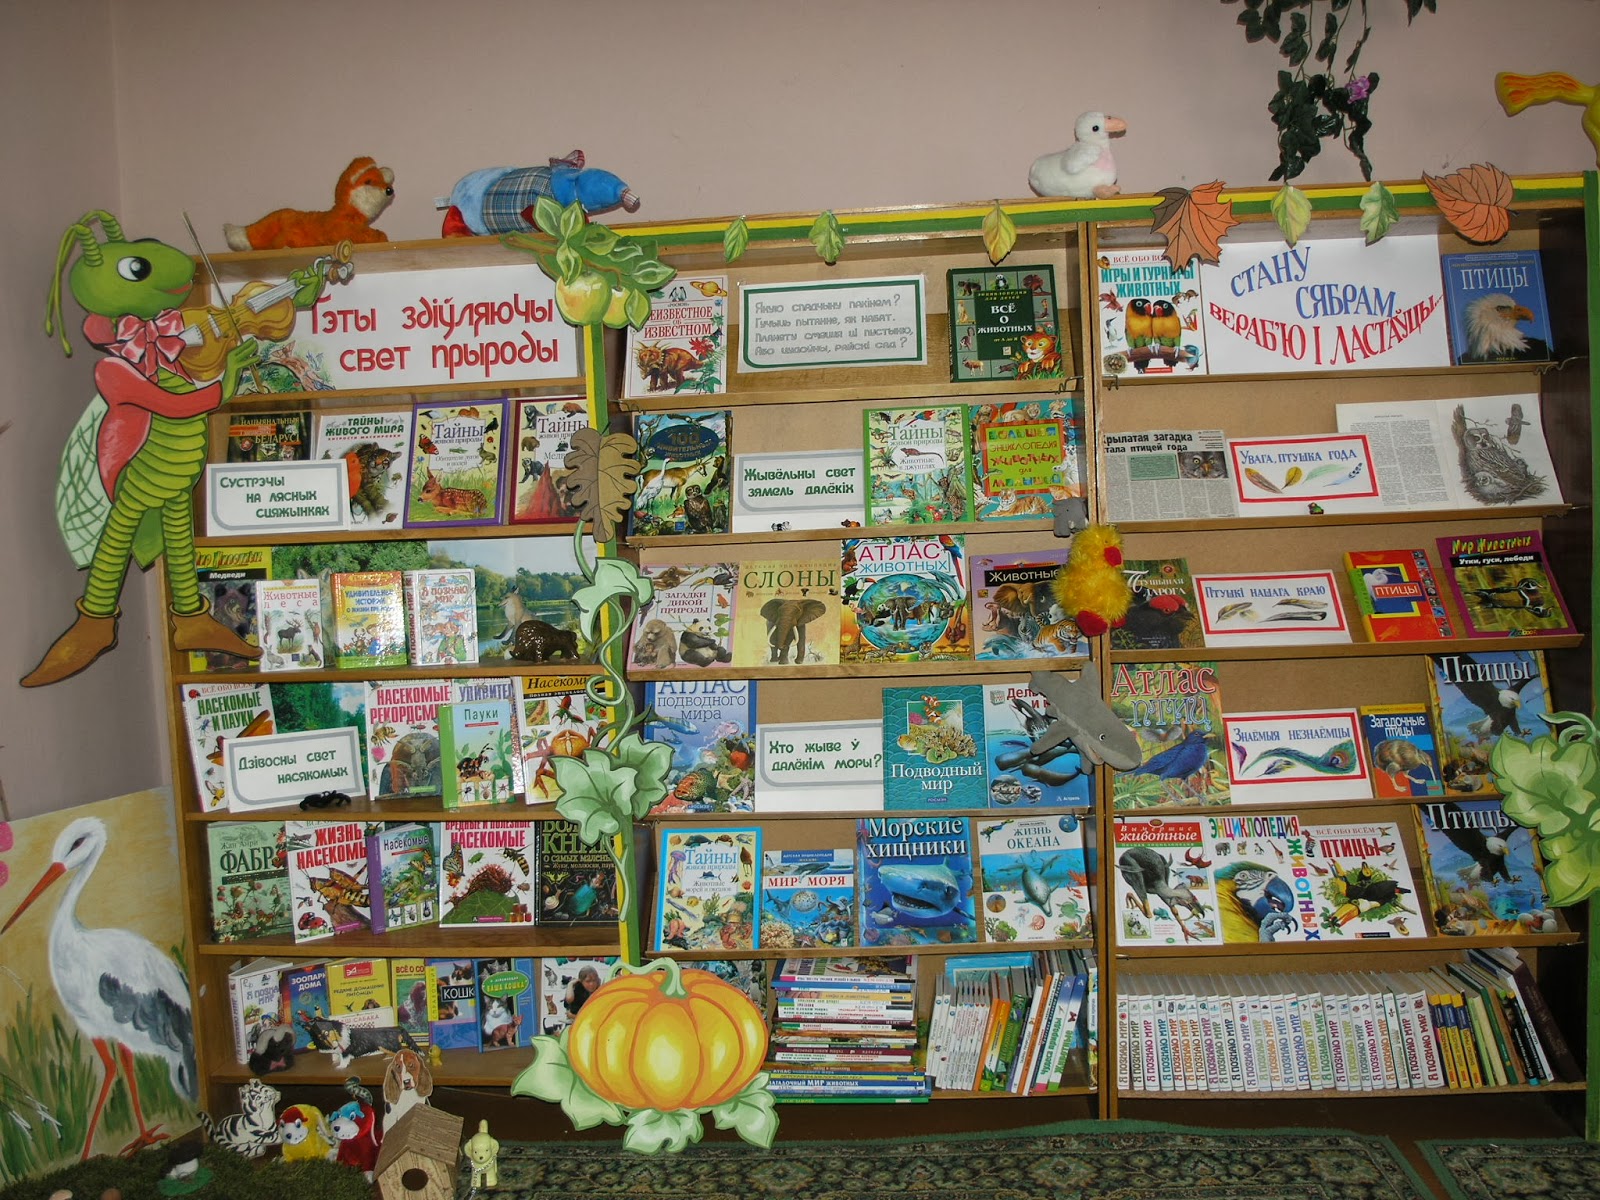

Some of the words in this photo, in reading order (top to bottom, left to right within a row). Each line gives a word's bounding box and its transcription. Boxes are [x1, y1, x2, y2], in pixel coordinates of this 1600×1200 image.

[1101, 267, 1131, 283] ИГРЫ
[1133, 266, 1140, 281] И
[1231, 246, 1311, 297] СТАНУ
[1461, 267, 1529, 293] ПТИЦЫ
[1116, 281, 1182, 298] ЖИВОТНЫХ
[755, 301, 784, 314] Якую
[791, 301, 842, 313] спадчыну
[991, 303, 1017, 314] ВСЁ
[1296, 283, 1396, 319] СЯБРАМ
[311, 293, 376, 334] Гэты
[401, 294, 554, 340] здіўляючы
[844, 316, 857, 324] як
[1000, 315, 1009, 324] О
[644, 323, 713, 339] ИЗВЕСТНОМ
[340, 345, 411, 372] свет
[432, 330, 558, 379] прыроды
[348, 415, 384, 425] ТАЙНЫ
[326, 427, 370, 436] ЖИВОГО
[373, 424, 404, 434] МИРА
[434, 423, 484, 439] Тайны
[889, 423, 943, 441] Тайны
[988, 426, 1057, 440] БОЛЬШАЯ
[1154, 433, 1193, 443] загадка
[989, 442, 1058, 453] ЭНЦИКЛОПЕДИЯ
[1130, 443, 1163, 453] птицей
[1167, 443, 1188, 452] года
[1278, 451, 1322, 463] ПТУШКА
[1328, 448, 1357, 461] ГОДА
[744, 467, 816, 481] Жывёльны
[825, 467, 855, 478] свет
[748, 487, 794, 497] зямель
[805, 482, 854, 495] далёкіх
[859, 543, 941, 562] АТЛАС
[1459, 558, 1481, 566] Утки,
[1482, 557, 1502, 565] гуси,
[1503, 554, 1534, 562] лебеди
[209, 571, 246, 579] Медведи
[859, 560, 948, 573] ЖИВОТНЫХ
[743, 569, 836, 589] СЛОНЫ
[263, 591, 318, 601] Животные
[1250, 585, 1290, 598] НАШАГА
[1297, 585, 1326, 597] КРАЮ
[1375, 585, 1418, 596] ПТИЦЫ
[660, 606, 709, 615] ПРИРОДЫ
[667, 598, 703, 607] ДИКОЙ
[1440, 656, 1531, 687] Птицы
[1111, 664, 1216, 697] Атлас
[198, 691, 262, 716] НАСЕКОМЫЕ
[377, 685, 450, 706] НАСЕКОМЫЕ
[658, 696, 746, 709] подводного
[464, 708, 499, 722] Пауки
[681, 707, 722, 722] мира
[1131, 696, 1212, 731] птиц
[1369, 715, 1426, 729] Загадочные
[212, 716, 220, 732] И
[1288, 725, 1350, 740] НЕЗНАЁМЦЫ
[1385, 727, 1414, 737] птицы
[769, 740, 794, 754] Хто
[805, 742, 842, 753] жыве
[238, 754, 297, 771] Дзівосны
[307, 750, 336, 763] свет
[771, 757, 825, 771] далёкім
[834, 754, 882, 770] моры?
[278, 767, 348, 784] насякомых
[892, 762, 983, 779] Подводный
[922, 778, 953, 794] мир
[315, 823, 363, 847] ЖИЗНЬ
[868, 817, 963, 842] Морские
[1013, 826, 1052, 836] ЖИЗНЬ
[1120, 830, 1197, 842] животные
[1208, 816, 1300, 840] ЭНЦИКЛОПЕДИЯ
[383, 835, 429, 850] Насекомые
[451, 830, 526, 849] НАСЕКОМЫЕ
[1007, 837, 1061, 849] ОКЕАНА
[685, 849, 737, 865] Тайны
[866, 840, 967, 861] хищники
[1320, 838, 1381, 860] ПТИЦЫ
[220, 846, 274, 873] ФАБР
[768, 877, 799, 887] МИР
[807, 875, 846, 886] МОРЯ
[1286, 838, 1321, 941] ЖИВОТНЫХ
[299, 981, 322, 992] ДОМА
[1144, 1020, 1152, 1037] МИР
[1158, 1019, 1167, 1036] МИР
[1225, 1019, 1234, 1036] МИР
[1276, 1016, 1286, 1035] МИР
[1290, 1014, 1301, 1033] МИР
[1364, 1020, 1374, 1037] МИР
[1418, 1014, 1428, 1033] МИР
[1145, 1040, 1155, 1074] ПОЗНАЮ
[1160, 1039, 1170, 1072] ПОЗНАЮ
[1228, 1039, 1239, 1072] ПОЗНАЮ
[1280, 1038, 1292, 1074] ПОЗНАЮ
[1293, 1036, 1308, 1074] ПОЗНАЮ
[1368, 1039, 1380, 1072] ПОЗНАЮ
[1422, 1035, 1436, 1072] ПОЗНАЮ
